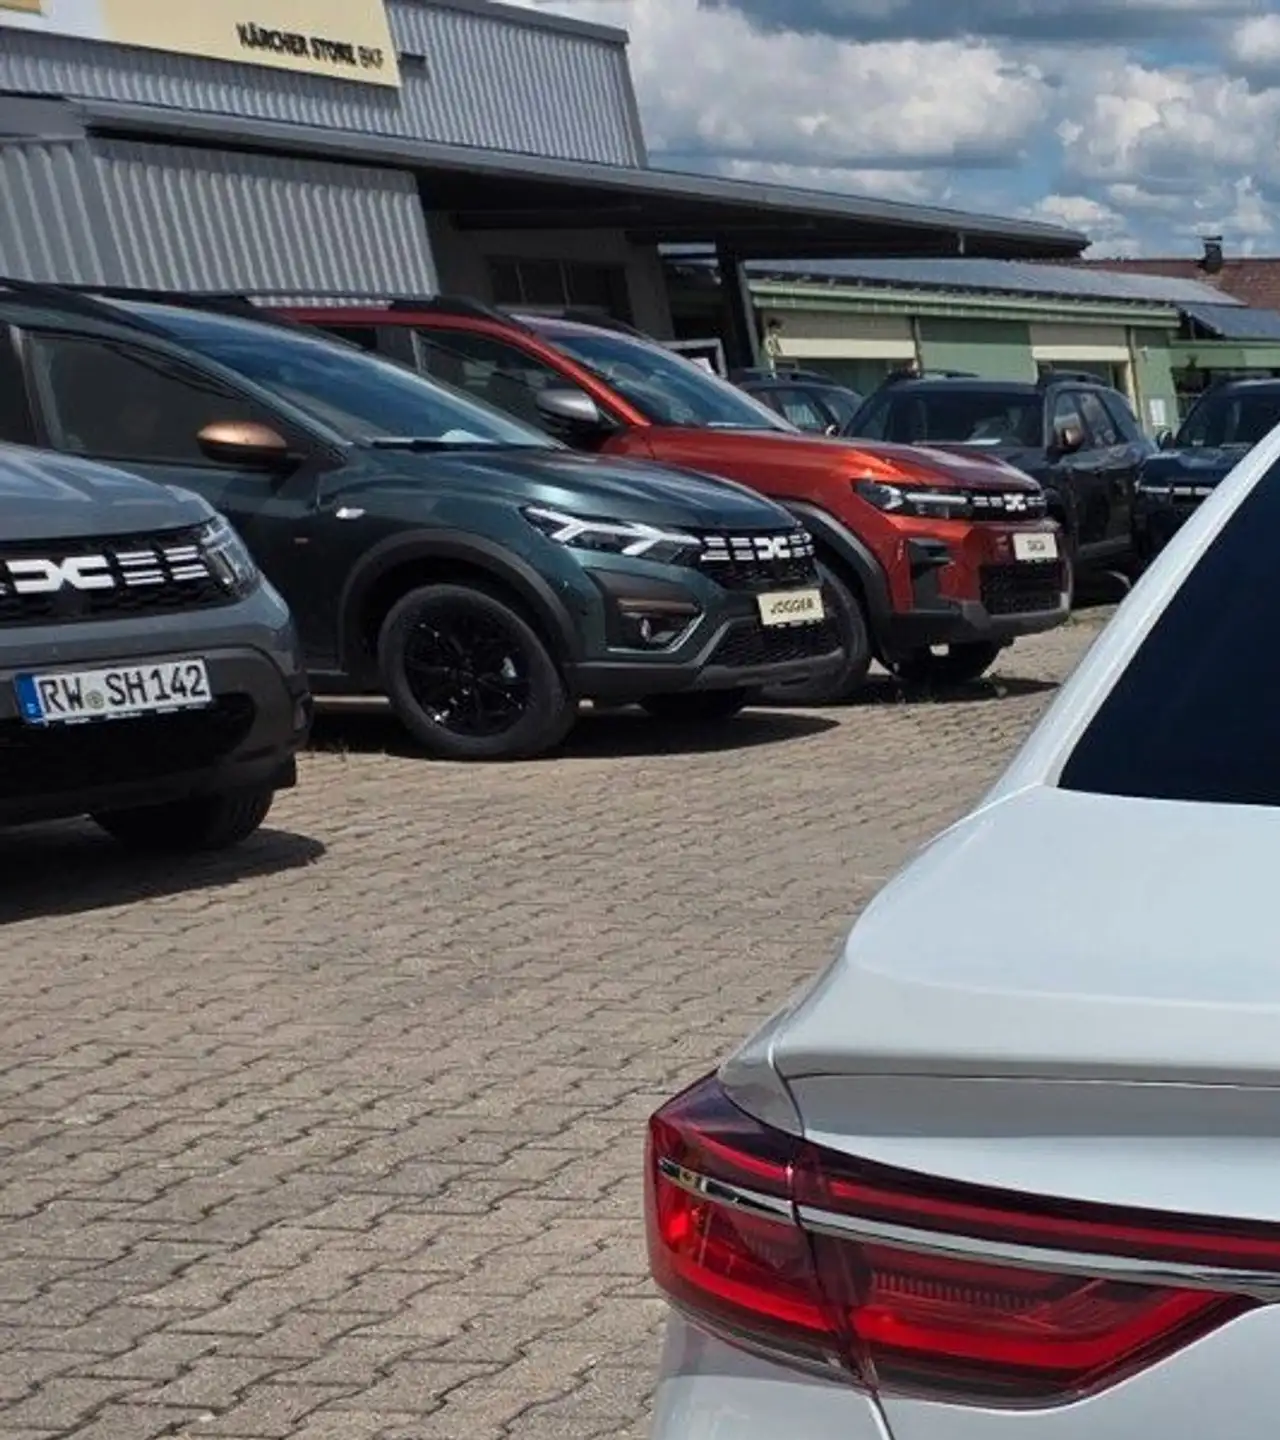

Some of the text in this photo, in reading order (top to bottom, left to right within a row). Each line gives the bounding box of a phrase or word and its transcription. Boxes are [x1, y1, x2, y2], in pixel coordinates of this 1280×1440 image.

[236, 22, 310, 58] KÄRCHER
[311, 37, 357, 66] STORE
[39, 676, 84, 714] RW
